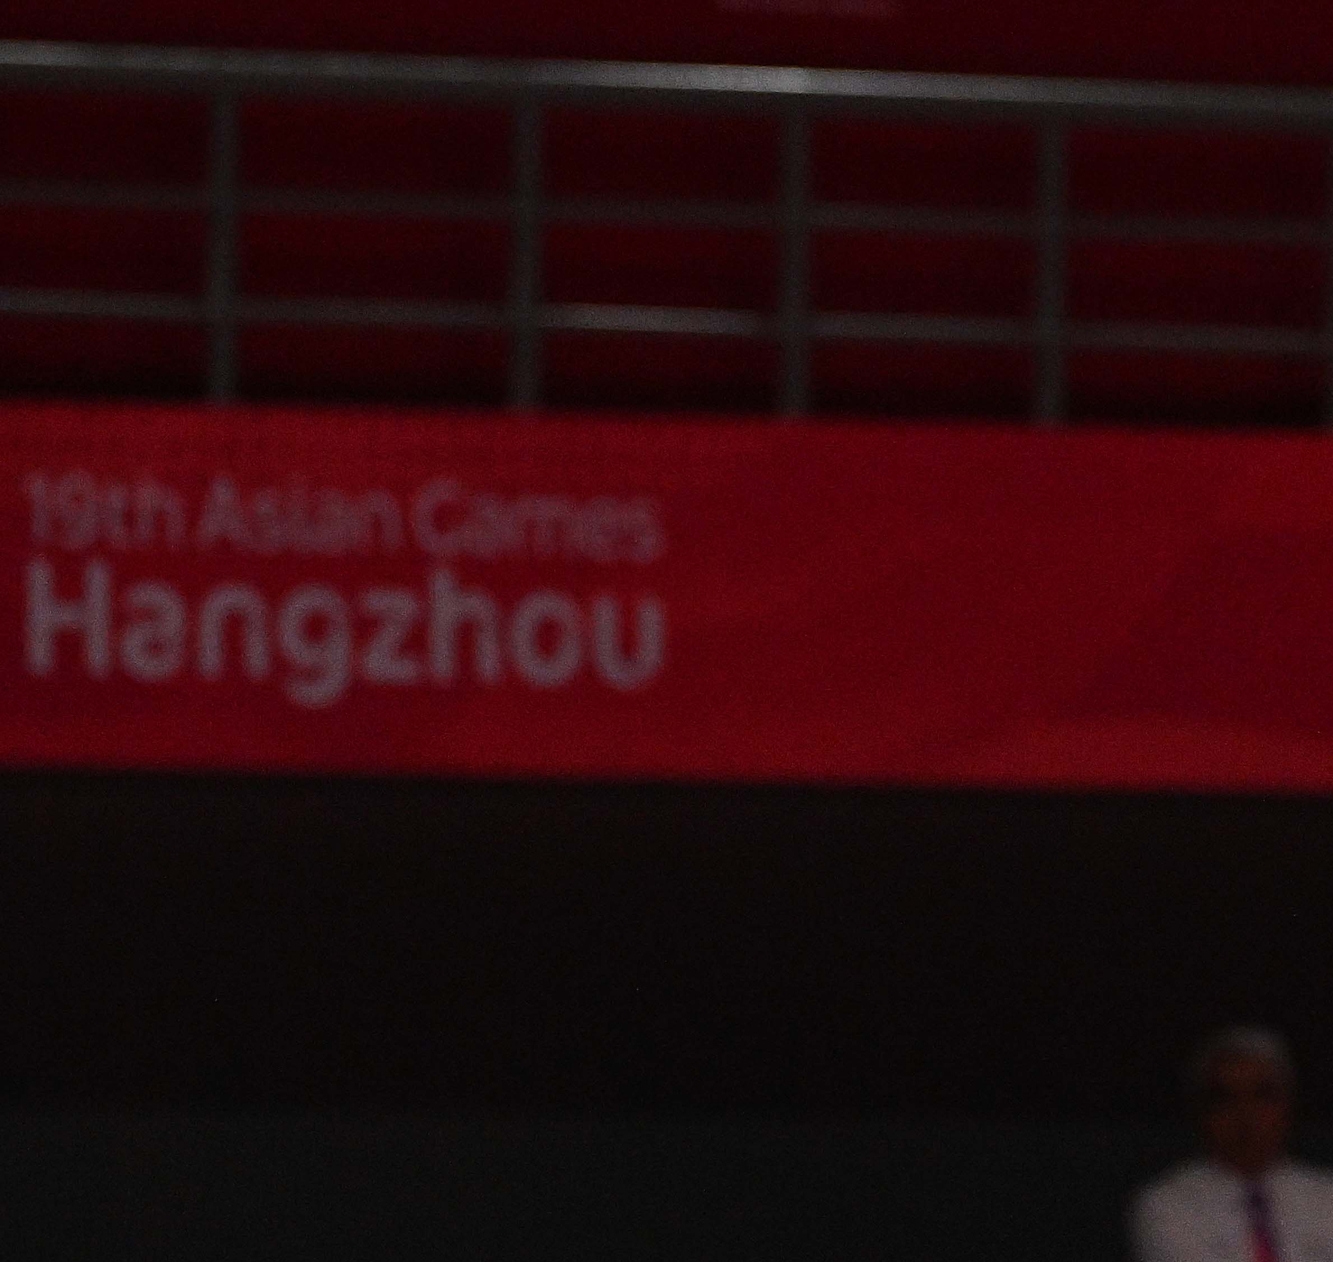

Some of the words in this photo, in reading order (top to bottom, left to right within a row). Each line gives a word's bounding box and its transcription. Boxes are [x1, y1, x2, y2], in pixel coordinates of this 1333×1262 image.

[25, 472, 182, 549] 19th
[198, 474, 403, 554] Asian
[411, 481, 664, 564] Games
[23, 559, 666, 708] Hangzhou
